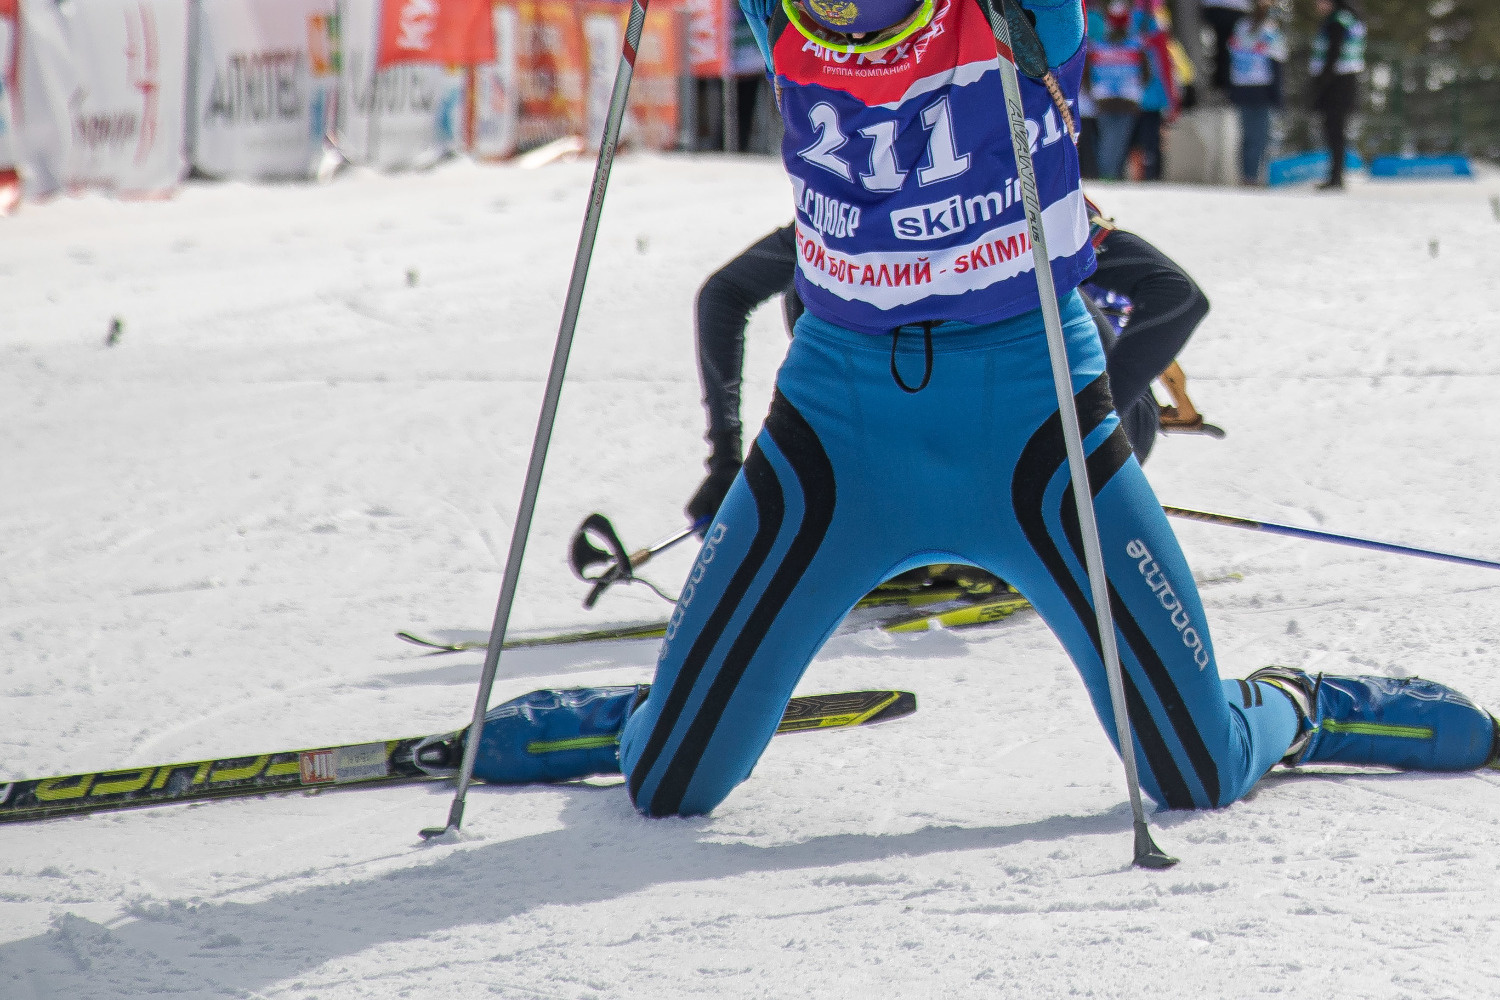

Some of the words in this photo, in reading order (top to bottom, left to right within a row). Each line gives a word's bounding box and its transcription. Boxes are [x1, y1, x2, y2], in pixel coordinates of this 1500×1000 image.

[822, 64, 853, 76] ГРУППА
[855, 62, 912, 78] КОМПАНИЙ
[797, 95, 972, 194] 211
[826, 254, 933, 288] БОГАЛИЙ
[1125, 537, 1209, 673] noname
